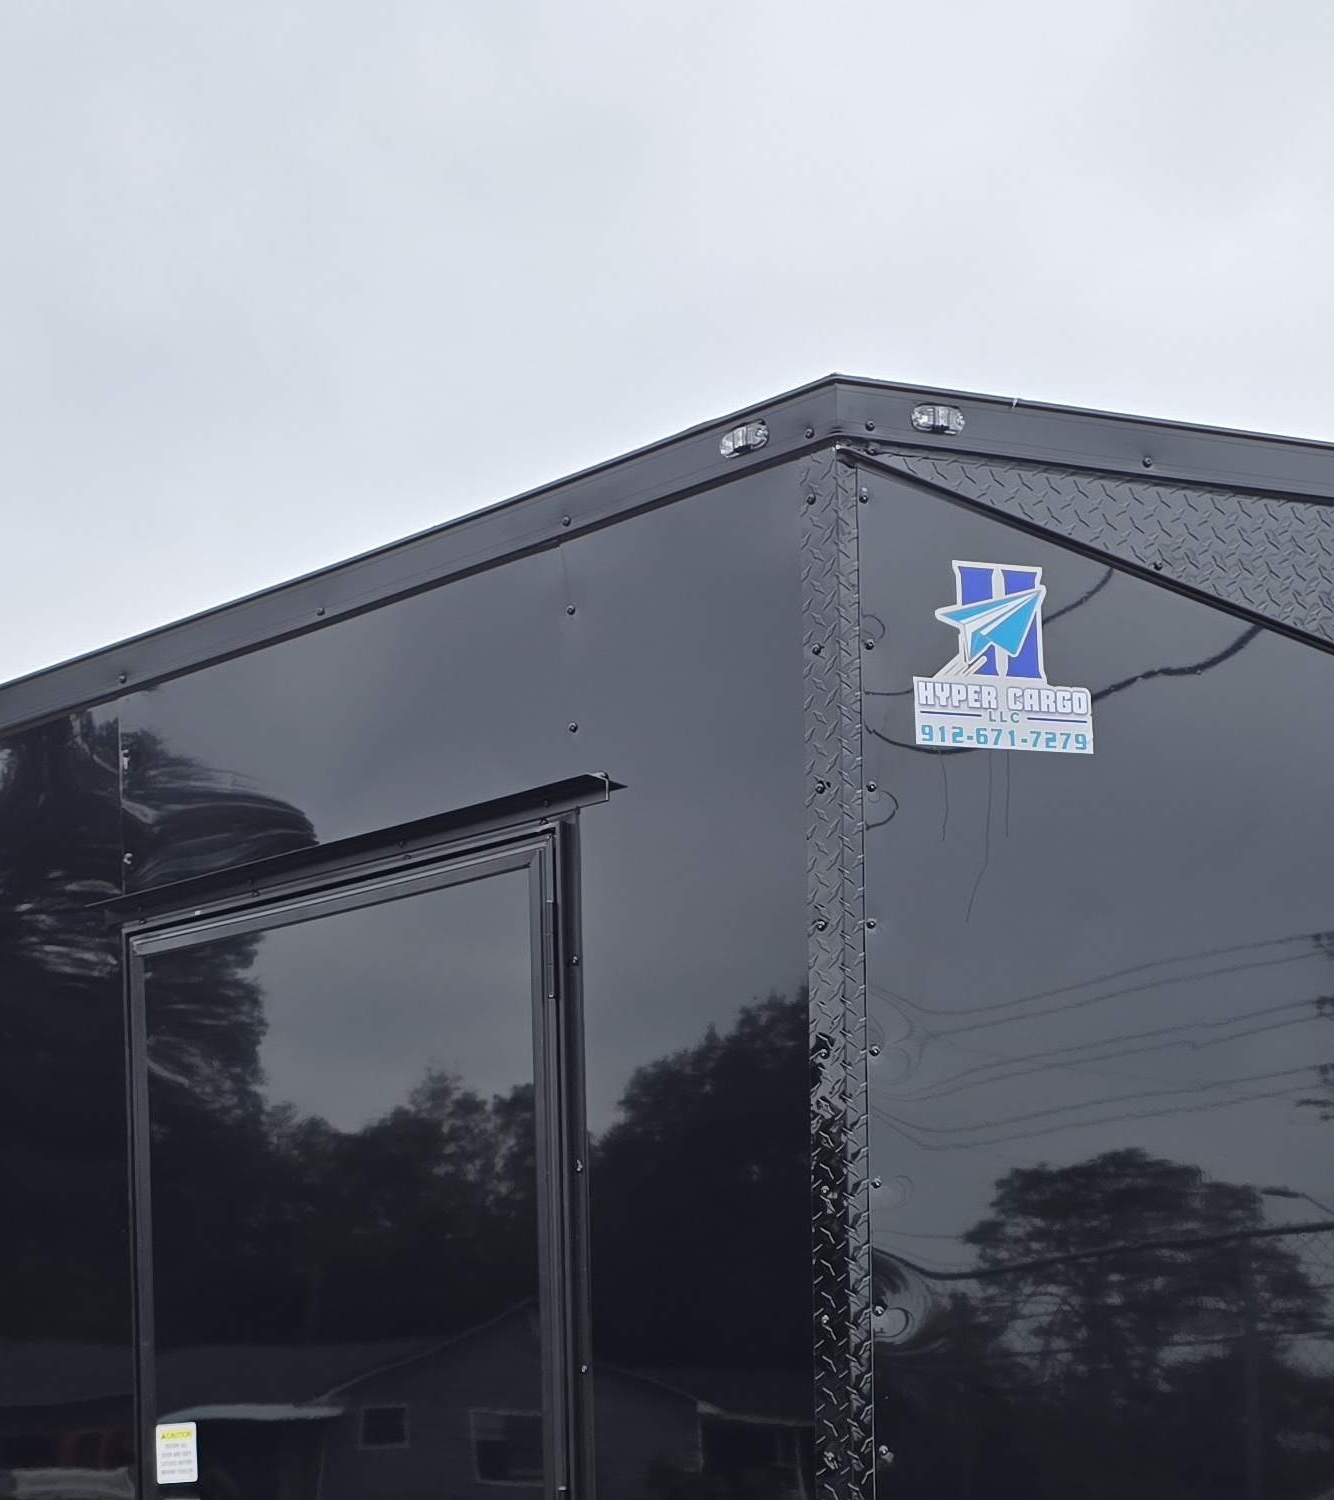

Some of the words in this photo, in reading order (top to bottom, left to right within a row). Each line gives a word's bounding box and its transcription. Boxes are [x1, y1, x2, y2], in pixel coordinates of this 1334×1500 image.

[917, 681, 998, 710] HYPER
[1007, 686, 1089, 715] CARGO
[988, 710, 1020, 724] LLC
[920, 724, 1088, 751] 912-671-7279
